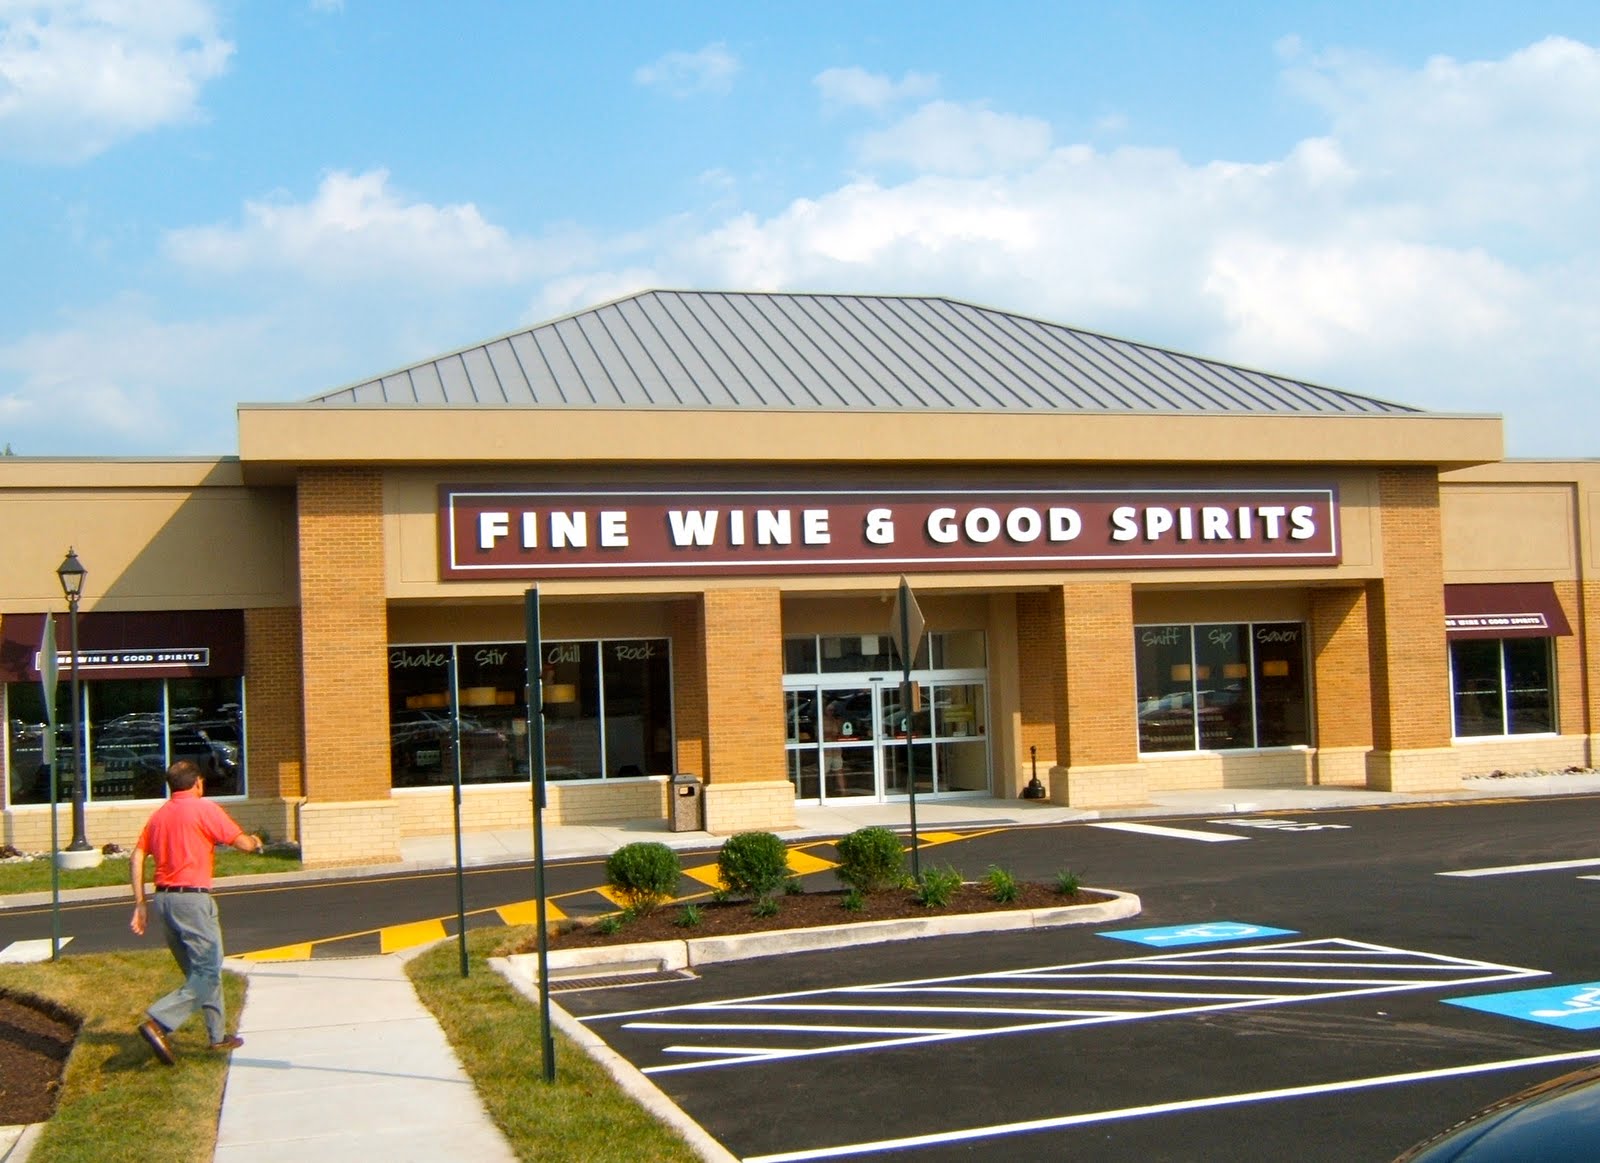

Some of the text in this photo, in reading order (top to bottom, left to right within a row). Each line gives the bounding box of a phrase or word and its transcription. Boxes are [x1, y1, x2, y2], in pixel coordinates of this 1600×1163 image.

[478, 505, 1316, 549] FINE WINE & GOOD SPIRITS
[1141, 627, 1182, 647] Sniff
[1208, 628, 1232, 653] Sip
[77, 655, 107, 664] WINE
[122, 654, 154, 662] GOOD
[157, 653, 201, 661] SPIRITS
[390, 642, 656, 670] Shake Stir Chill Rock
